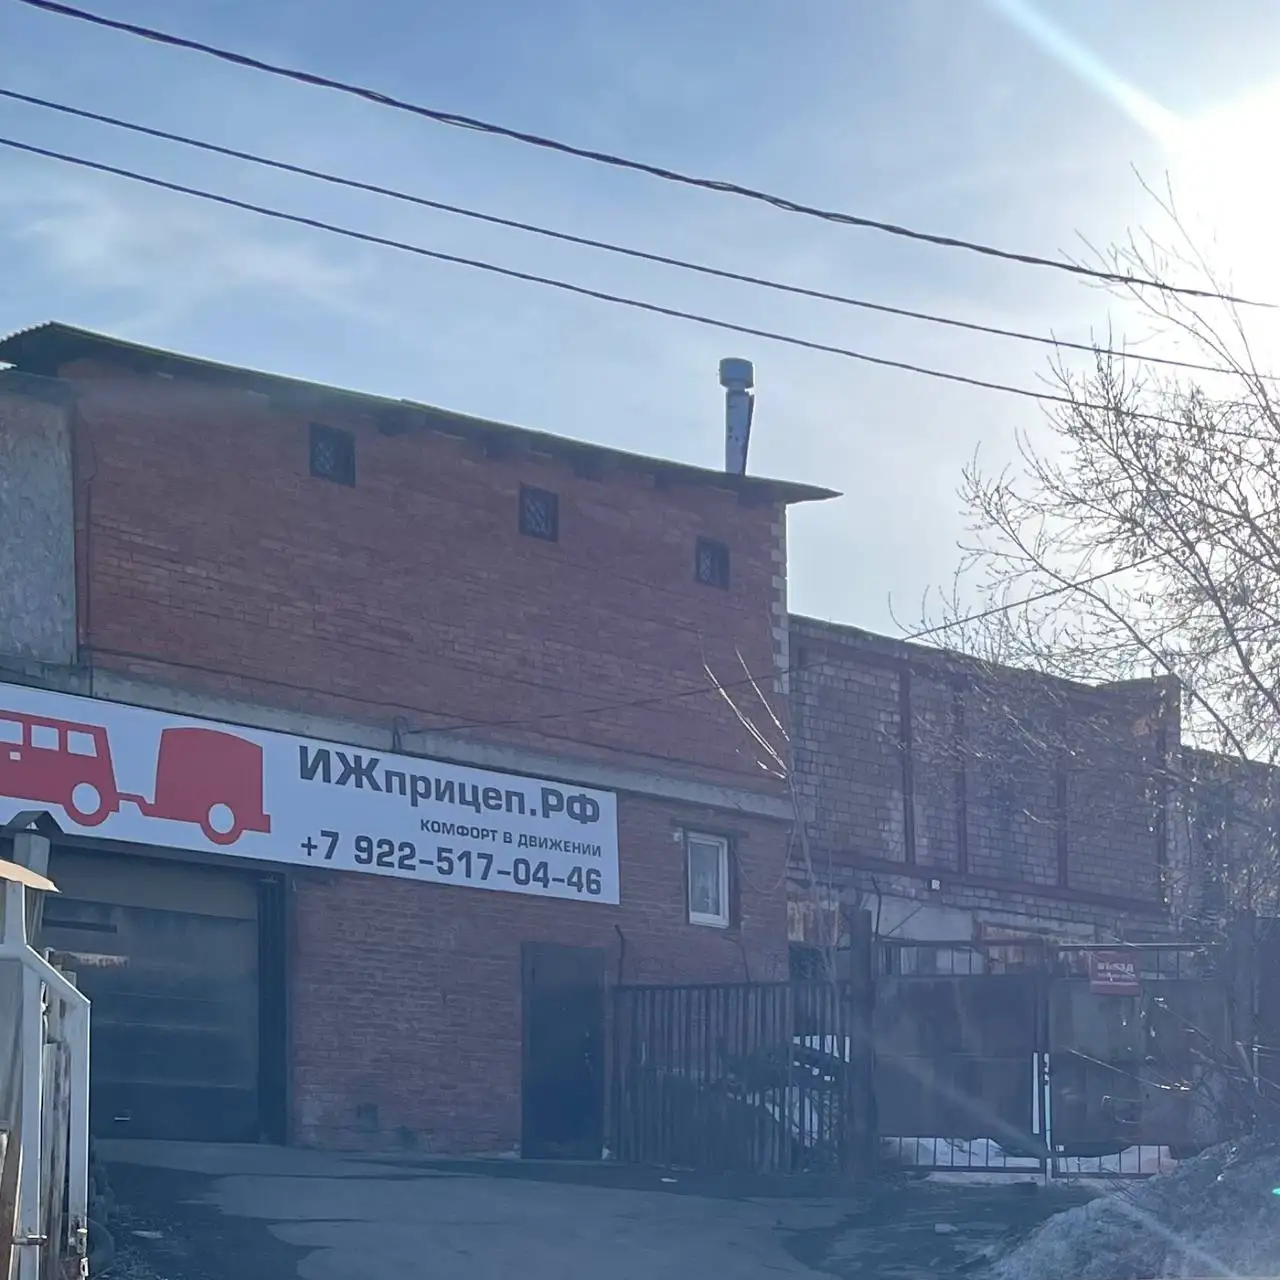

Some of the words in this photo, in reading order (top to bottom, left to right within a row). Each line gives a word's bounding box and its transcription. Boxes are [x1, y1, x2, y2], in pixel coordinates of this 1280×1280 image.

[299, 745, 600, 824] ИЖприцеп.РФ
[301, 830, 340, 860] +7
[354, 835, 602, 895] 922-517-04-46
[420, 819, 498, 842] КОМФОРТ
[503, 830, 514, 845] В
[517, 834, 602, 857] ДВИЖЕНИИ
